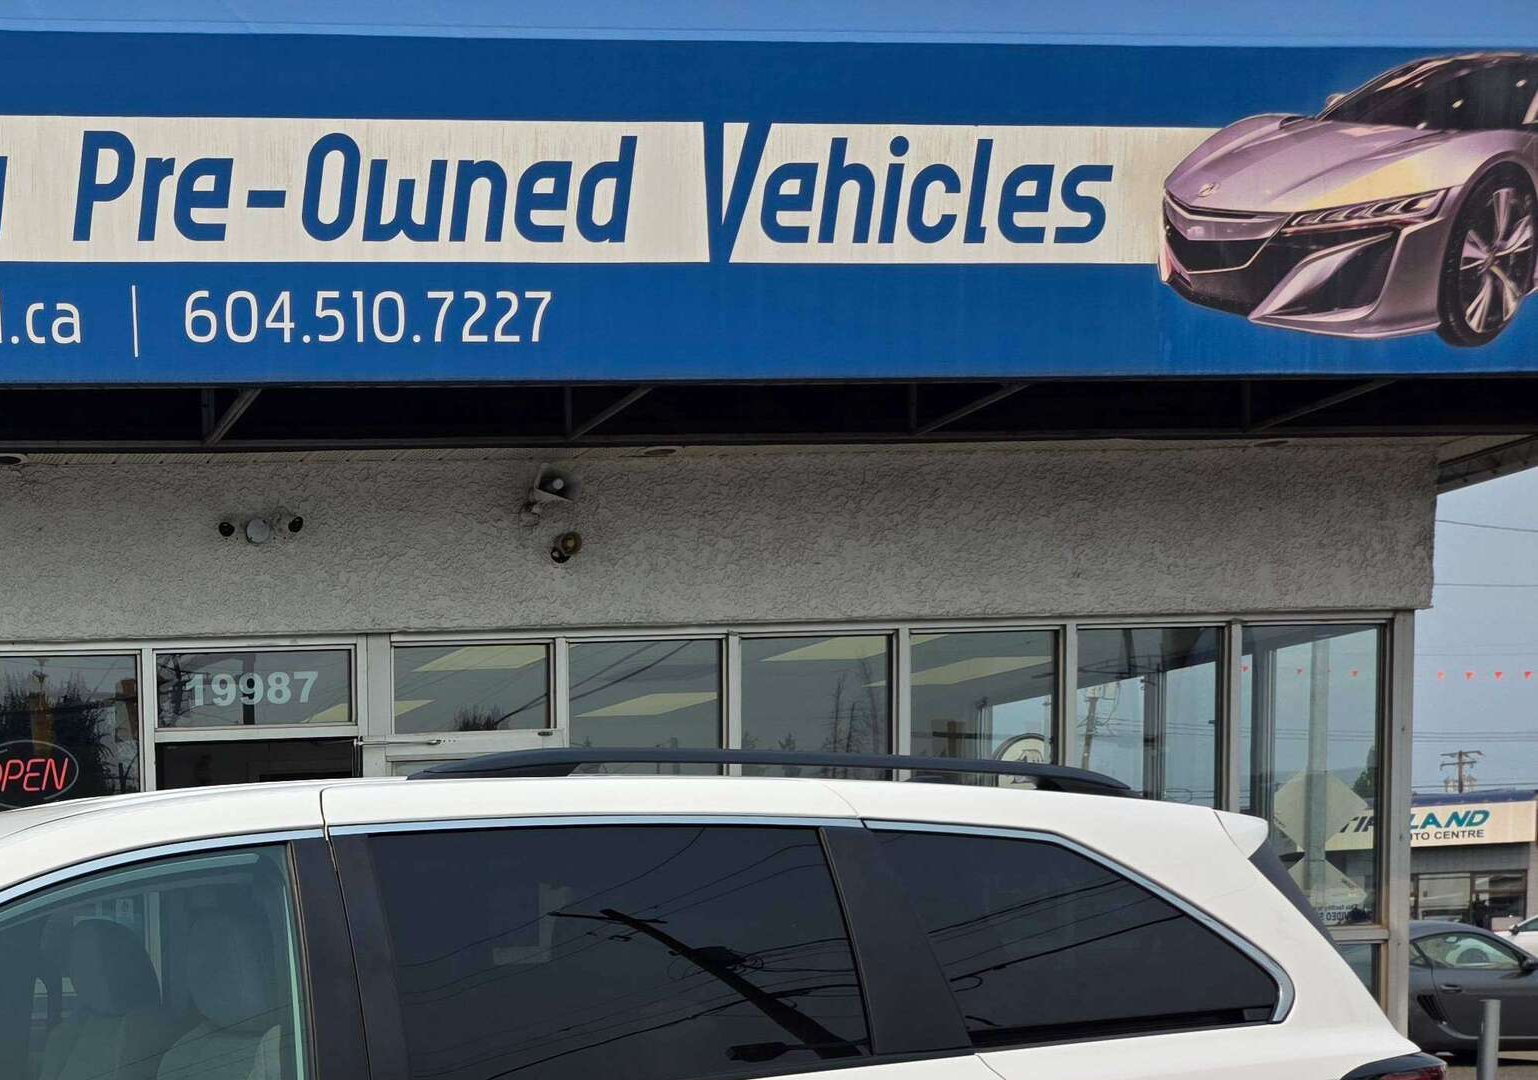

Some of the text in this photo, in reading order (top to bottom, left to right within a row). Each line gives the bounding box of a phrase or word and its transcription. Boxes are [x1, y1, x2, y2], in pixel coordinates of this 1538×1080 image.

[74, 129, 639, 243] Pre-Owned
[705, 115, 1114, 264] Vehicles
[183, 288, 552, 345] 604.510.7227
[184, 670, 319, 707] 19987
[1433, 828, 1486, 841] CENTRE
